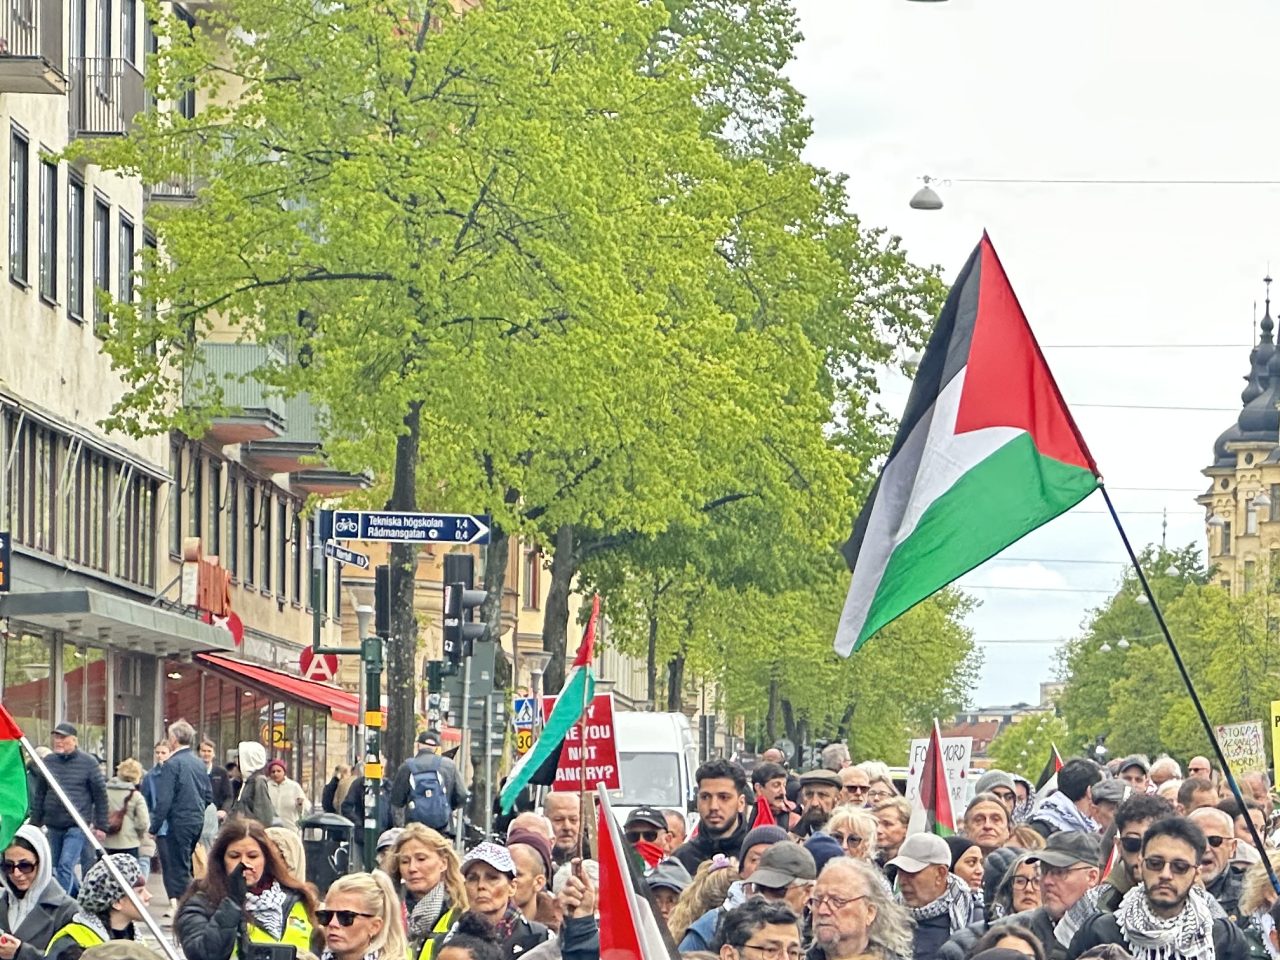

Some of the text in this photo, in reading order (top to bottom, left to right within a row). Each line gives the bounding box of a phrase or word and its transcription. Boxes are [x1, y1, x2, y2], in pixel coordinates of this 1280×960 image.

[368, 515, 468, 529] Tekniska högskolan 1,4
[367, 527, 426, 539] Rådmansgatan
[455, 530, 468, 540] 0,4
[305, 651, 332, 681] A
[517, 735, 532, 749] 30
